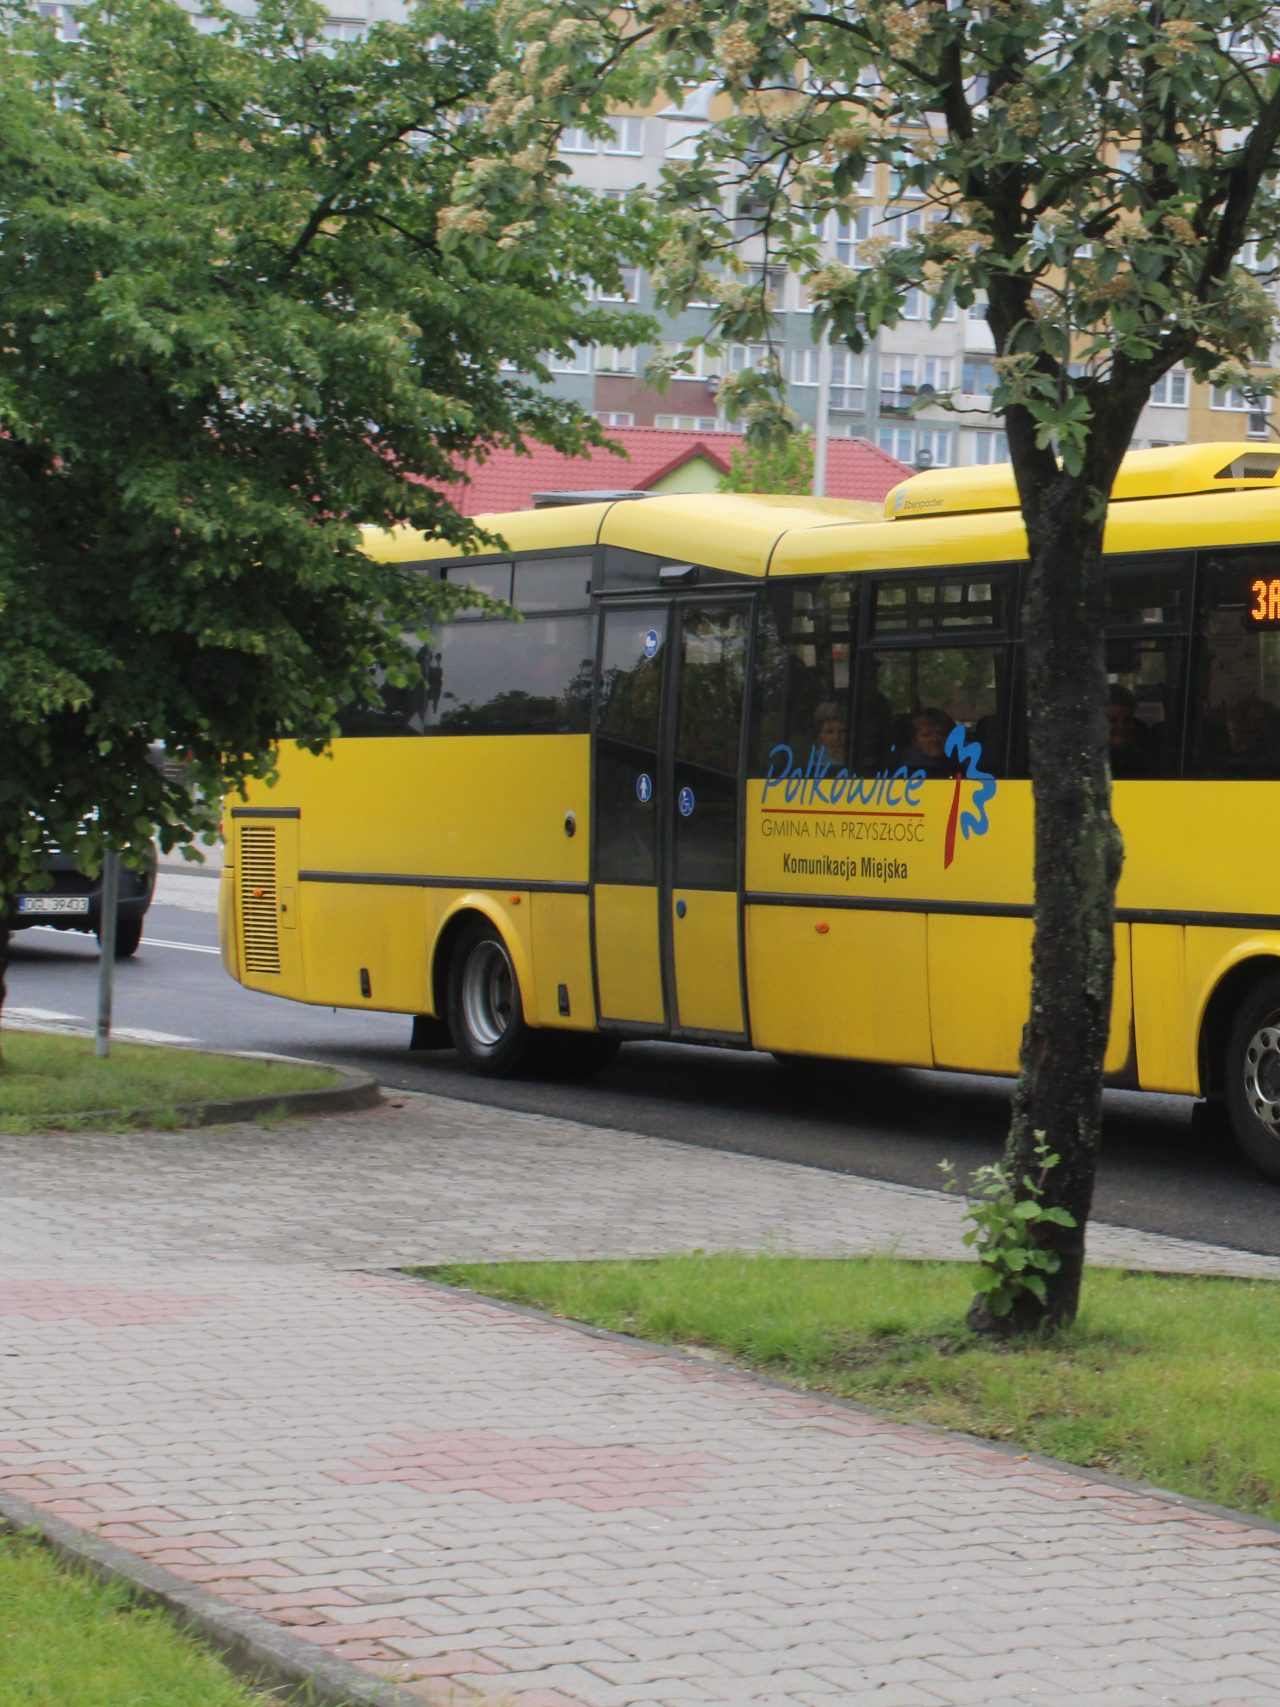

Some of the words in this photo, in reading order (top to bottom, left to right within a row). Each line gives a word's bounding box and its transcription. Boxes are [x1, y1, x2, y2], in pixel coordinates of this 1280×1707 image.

[760, 743, 926, 806] Polkowice
[761, 818, 810, 838] GMINA
[814, 823, 836, 838] NA
[840, 818, 925, 843] PRZYSZŁOŚĆ
[783, 853, 857, 881] Komunikacja
[860, 857, 908, 883] Miejska
